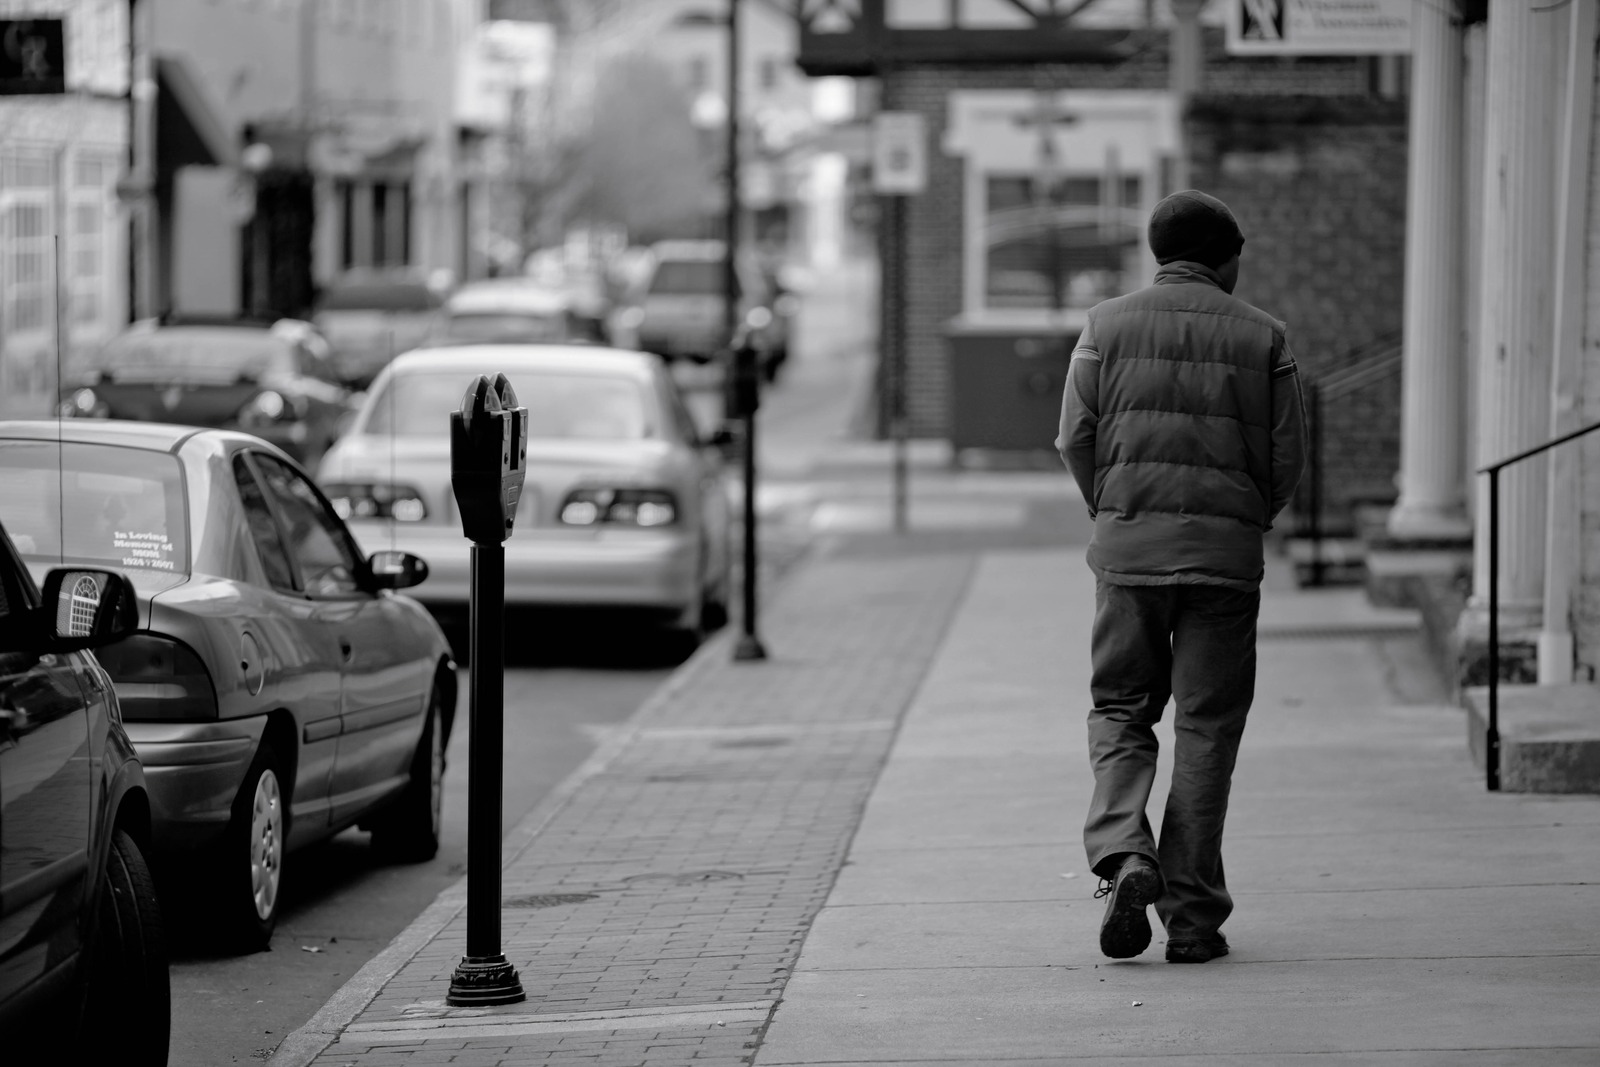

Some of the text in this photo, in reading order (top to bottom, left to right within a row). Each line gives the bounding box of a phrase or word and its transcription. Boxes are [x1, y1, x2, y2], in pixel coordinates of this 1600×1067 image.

[114, 531, 168, 543] In Loving
[113, 540, 173, 551] Memory of
